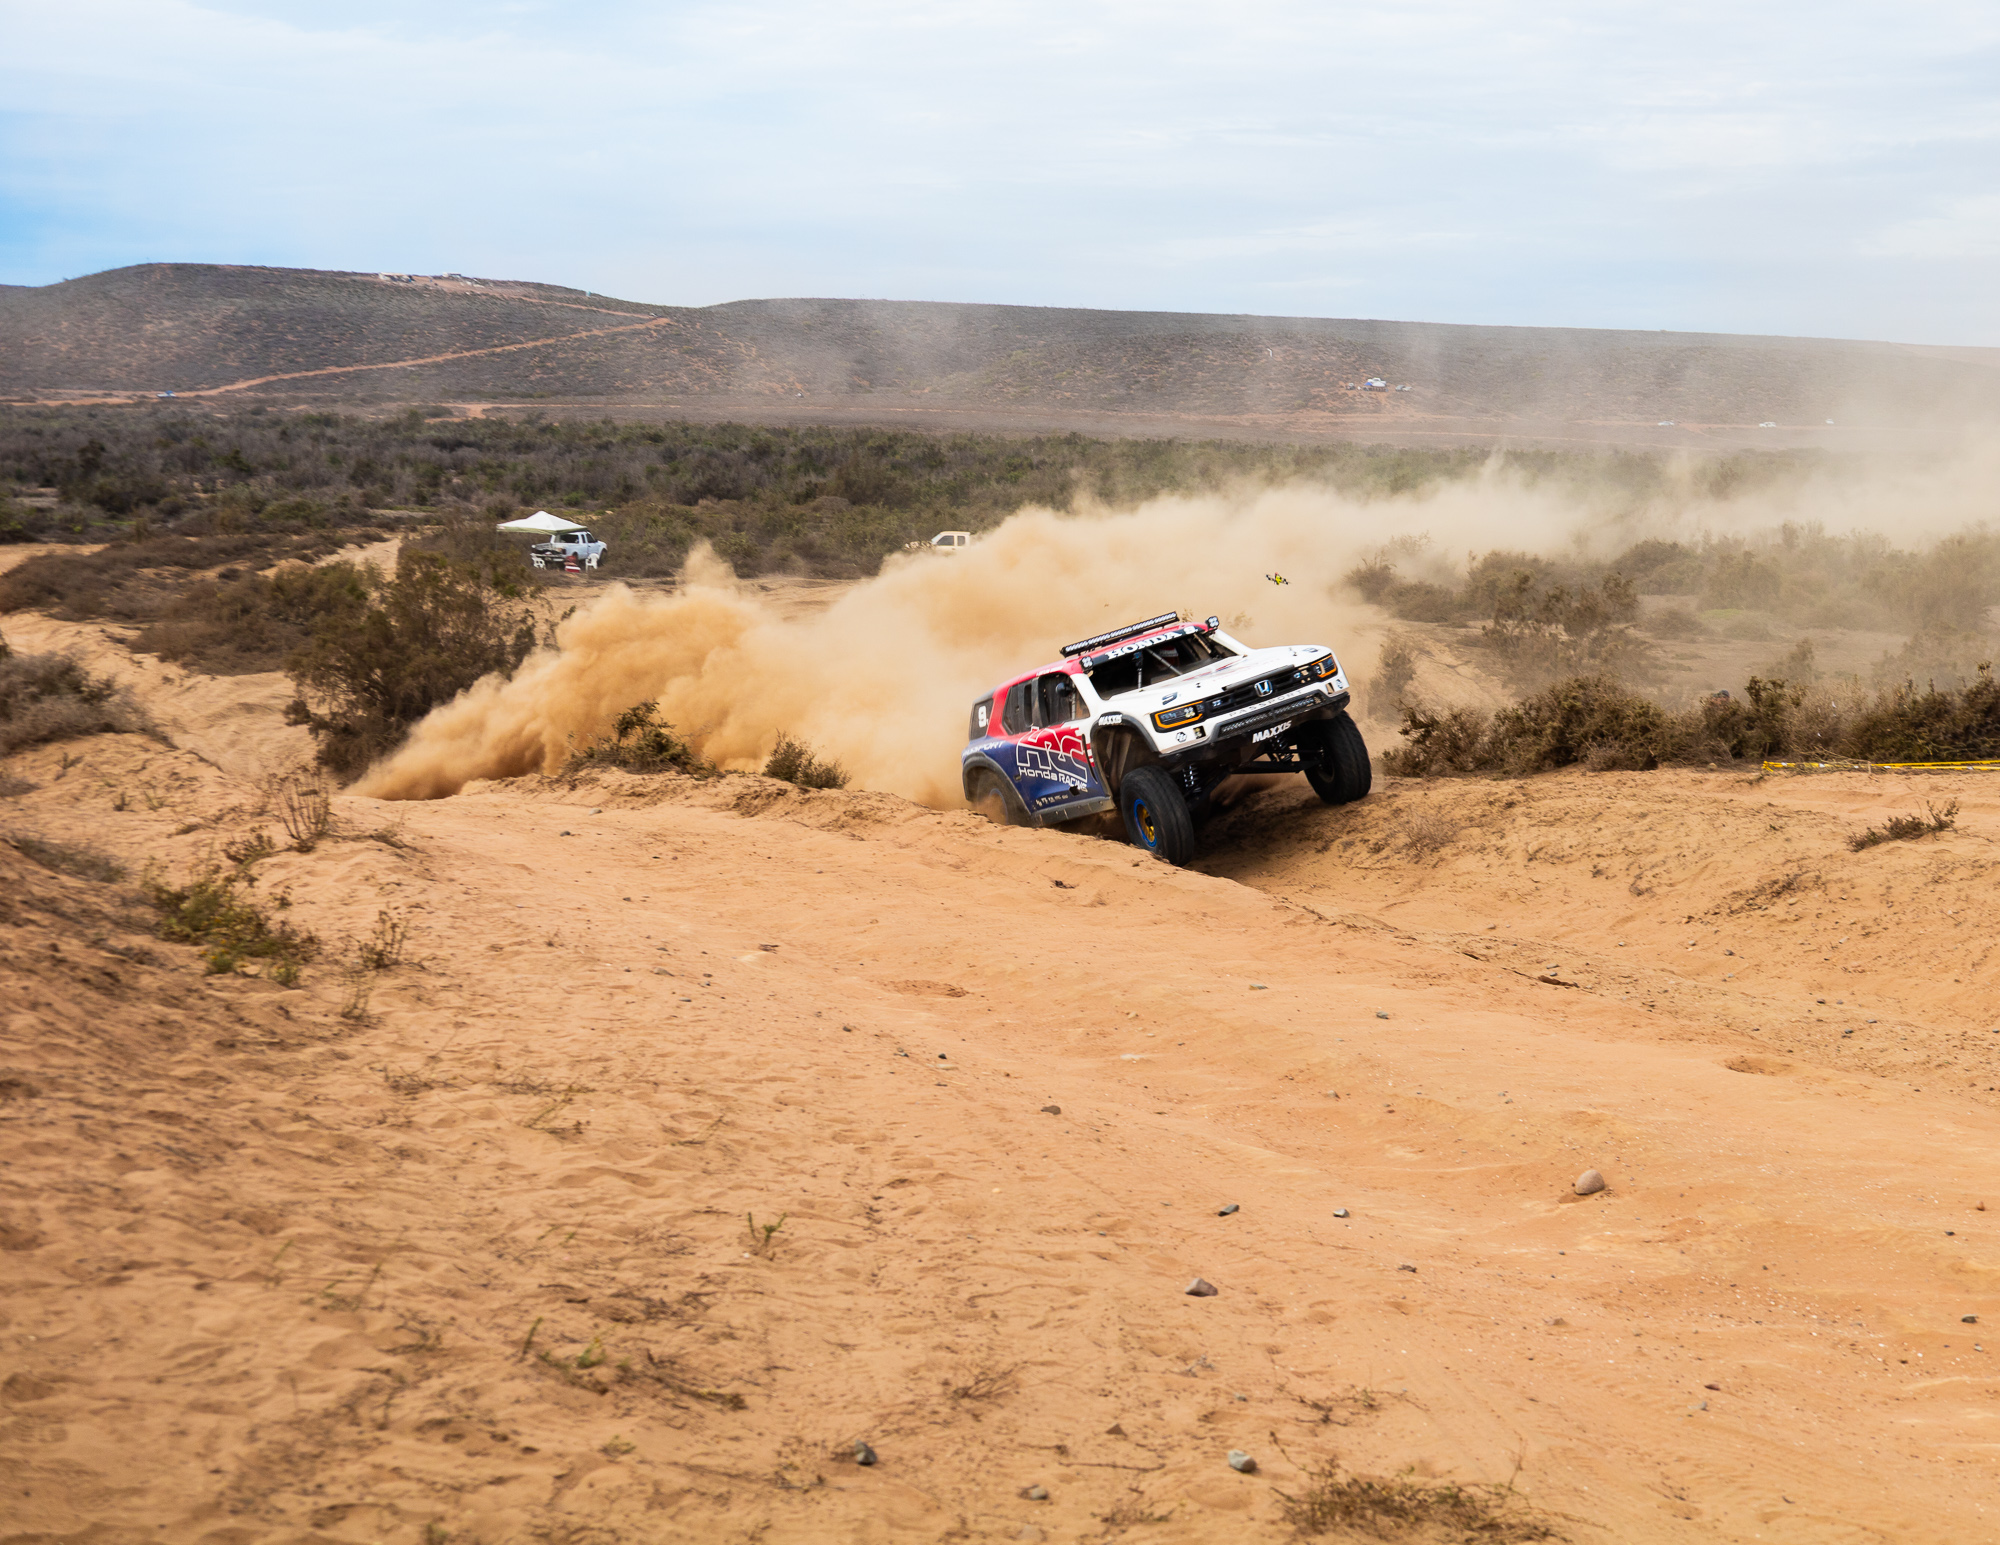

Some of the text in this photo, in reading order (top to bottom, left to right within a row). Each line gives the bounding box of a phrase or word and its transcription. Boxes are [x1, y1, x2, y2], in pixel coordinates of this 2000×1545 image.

[1105, 632, 1182, 659] HONDA
[1252, 720, 1293, 744] MAXXIS
[1018, 766, 1088, 792] Honda RACING
